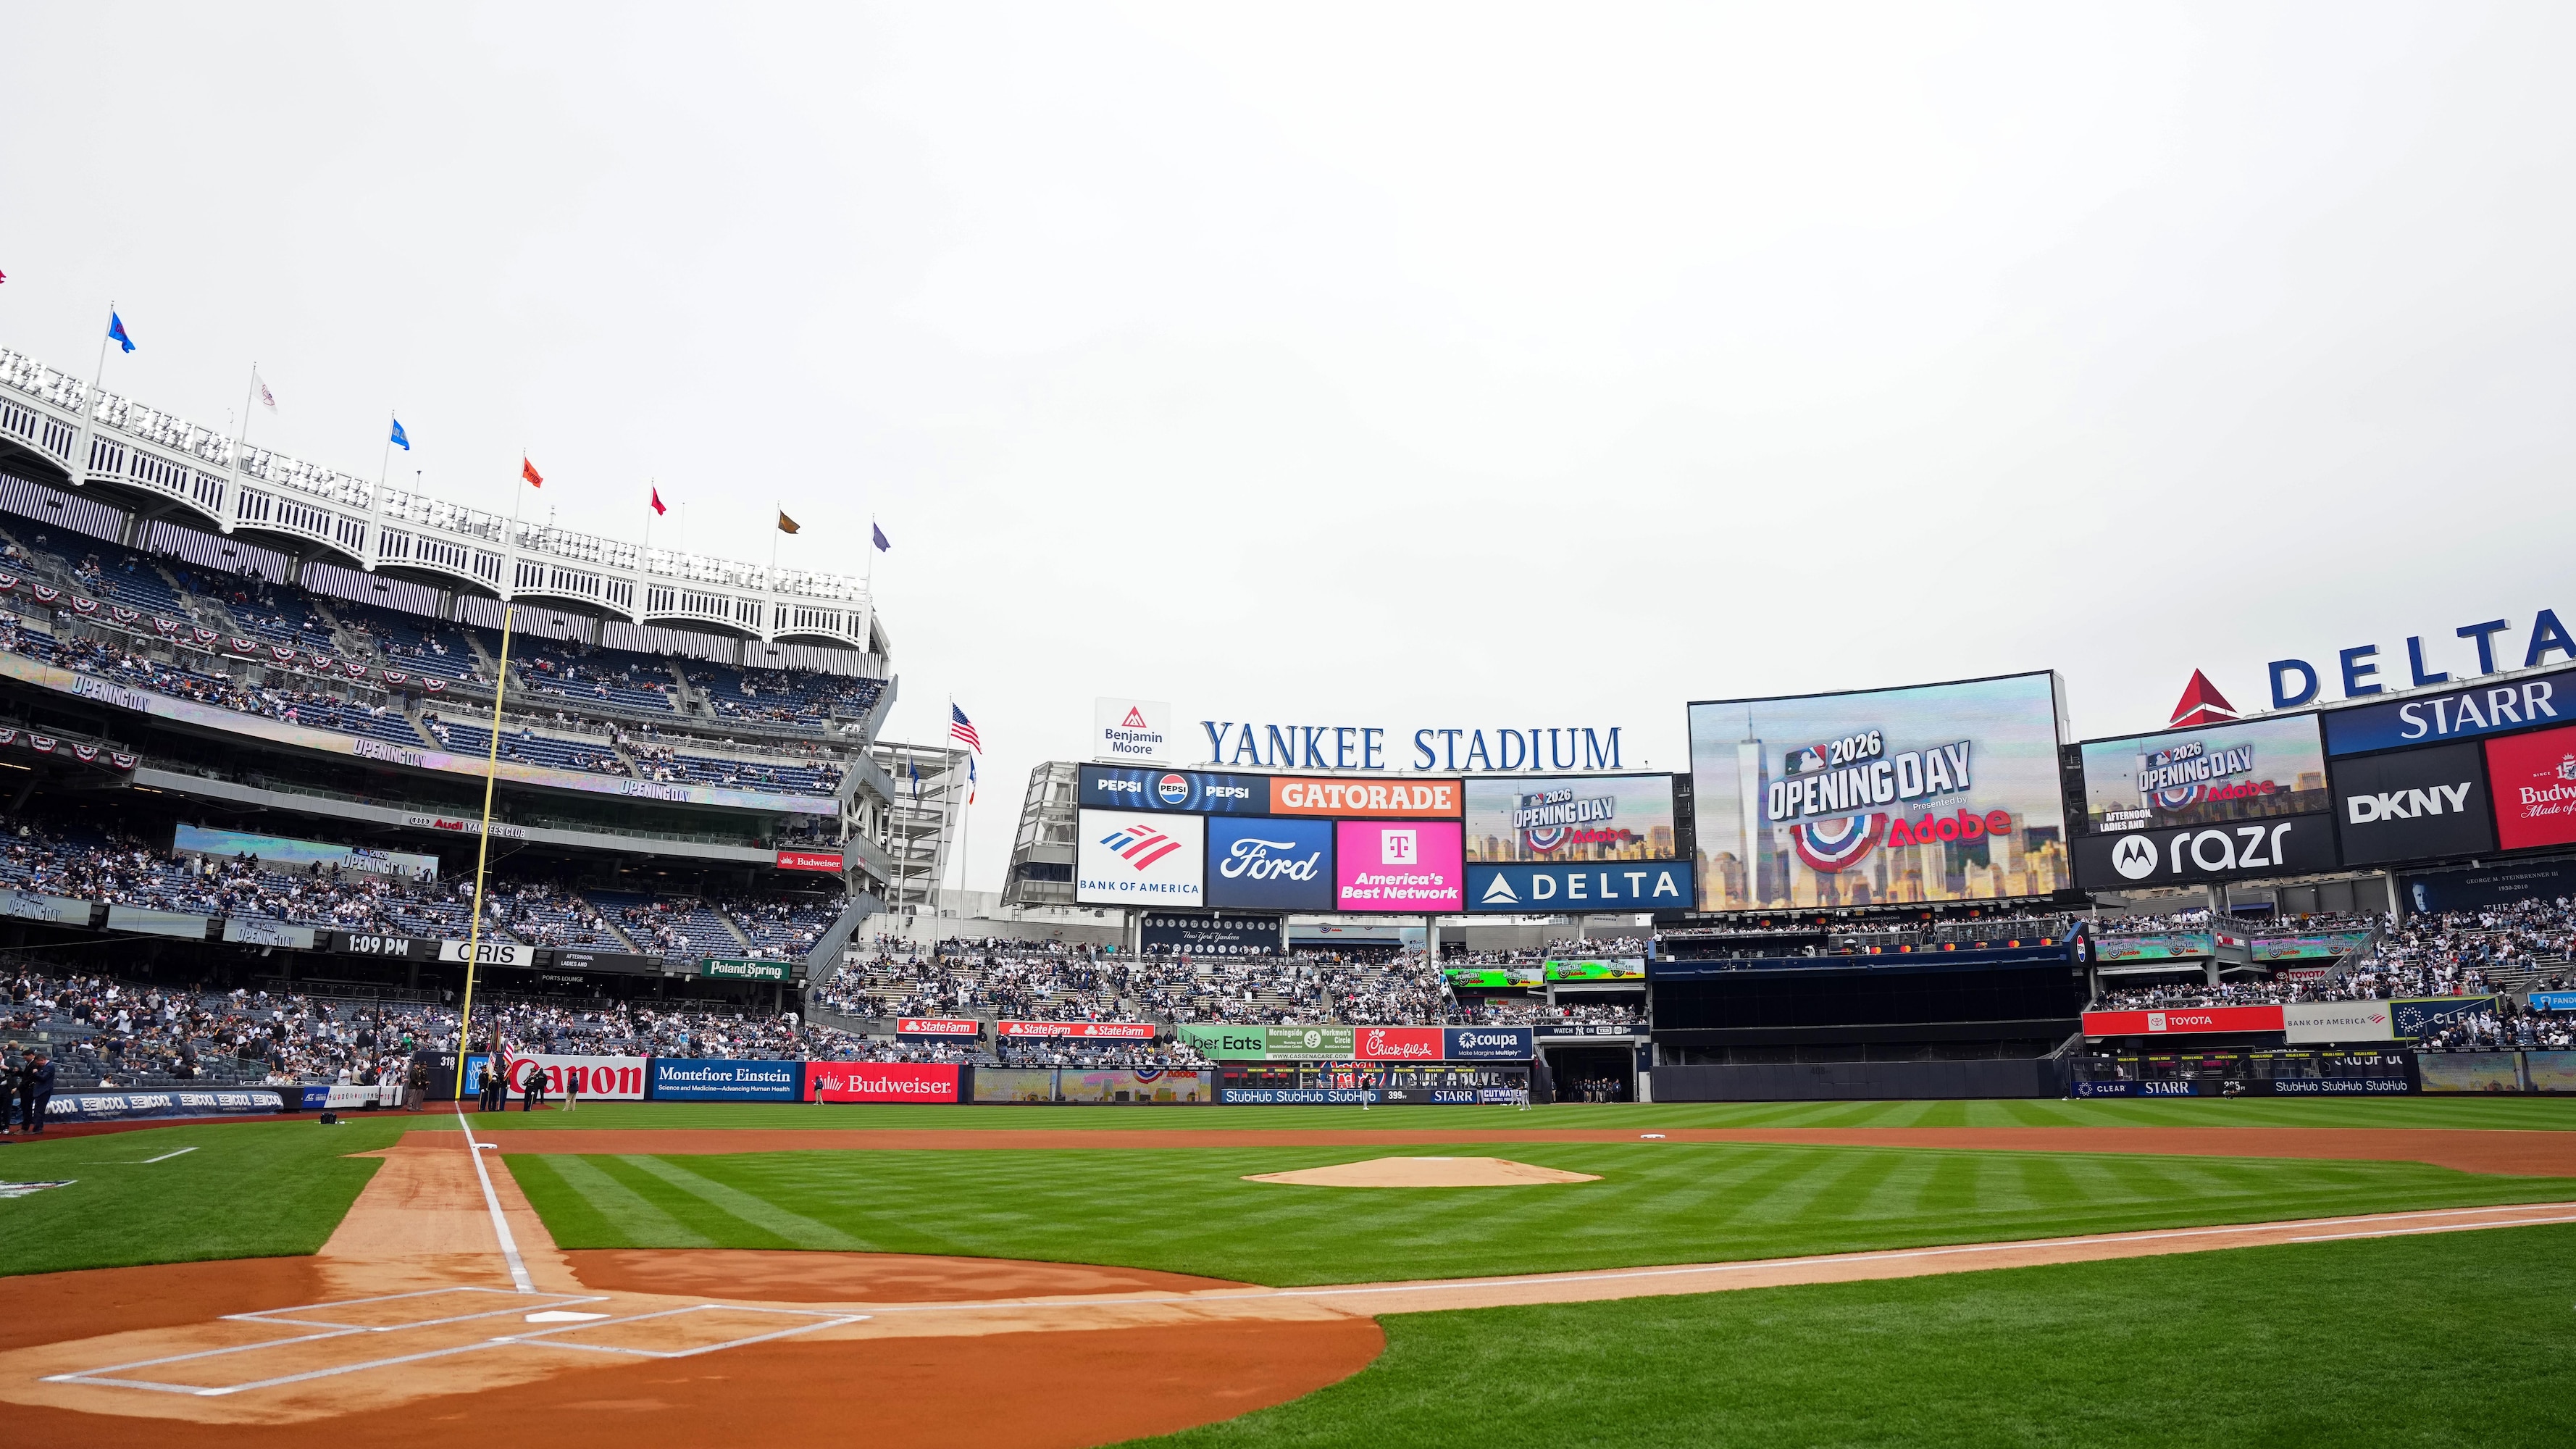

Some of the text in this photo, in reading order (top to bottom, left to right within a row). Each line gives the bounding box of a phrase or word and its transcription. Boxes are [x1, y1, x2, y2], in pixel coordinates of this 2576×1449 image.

[2268, 609, 2576, 709] DELTA
[2400, 681, 2559, 739] STARR
[1105, 729, 1162, 743] Benjamin
[1113, 742, 1152, 754] Moore
[1200, 721, 1623, 772] YANKEE STADIUM
[1831, 730, 1881, 765] 2026
[2173, 742, 2201, 761] 2026
[2138, 746, 2251, 791] OPENING DAY
[1098, 780, 1141, 793] PEPSI
[1768, 740, 1970, 820] OPENING DAY
[1206, 786, 1249, 798] PEPSI
[1281, 782, 1452, 810] GATORADE
[1546, 789, 1571, 803] 2026
[2208, 780, 2275, 802] Adobe
[1912, 796, 1967, 811] Presented by
[2347, 782, 2472, 824] DKNY
[1513, 796, 1613, 828] OPENING DAY
[2106, 809, 2152, 822] AFTERNOON,
[2521, 803, 2561, 818] Made
[434, 819, 525, 838] Audi YANEES CLUB
[1888, 809, 2012, 847] Adobe
[2101, 819, 2144, 832] LADIES AND
[1572, 827, 1631, 843] Adobe
[1390, 837, 1408, 857] T
[2171, 822, 2291, 873] razr
[370, 850, 388, 859] 2026
[1220, 838, 1321, 882] Ford
[341, 852, 391, 873] OPENING
[797, 858, 840, 868] Budweiser
[1355, 873, 1443, 885] America's
[2502, 872, 2549, 881] STEINBRENNER
[1080, 880, 1115, 890] BANK
[1139, 883, 1198, 893] AMERICA
[1341, 886, 1458, 898] Best Network
[1533, 872, 1679, 900] DELTA
[29, 894, 45, 905] 2026
[7, 899, 62, 922] OPENING DAY
[236, 927, 295, 948] OPENING DAY
[1197, 932, 1213, 942] York
[1213, 932, 1239, 943] Yankees
[349, 935, 409, 956] 1:09 PM
[710, 961, 782, 979] Poland Spring
[921, 1022, 970, 1032] State Farm
[2170, 1016, 2212, 1026] TOYOTA
[1024, 1024, 1071, 1035] State Farm
[1099, 1025, 1144, 1036] State Farm
[1269, 1029, 1302, 1037] Morningside
[1224, 1036, 1262, 1050] Eats
[1366, 1033, 1432, 1057] Chick-fil-A
[1477, 1035, 1517, 1048] coupa
[440, 1056, 455, 1066] 318
[509, 1059, 642, 1094] Canon
[659, 1066, 790, 1082] Montefiore Einstein
[848, 1075, 950, 1094] Budweiser
[2146, 1082, 2189, 1093] STARR
[2276, 1080, 2407, 1092] StubHub StubHub StubHub
[149, 1095, 172, 1107] COOL
[197, 1095, 217, 1106] COOL
[233, 1095, 251, 1106] COOL
[267, 1095, 283, 1106] COOL
[1226, 1091, 1376, 1103] StubHub StubHub StubHb
[1434, 1090, 1473, 1101] STARR
[103, 1097, 129, 1110] COOL
